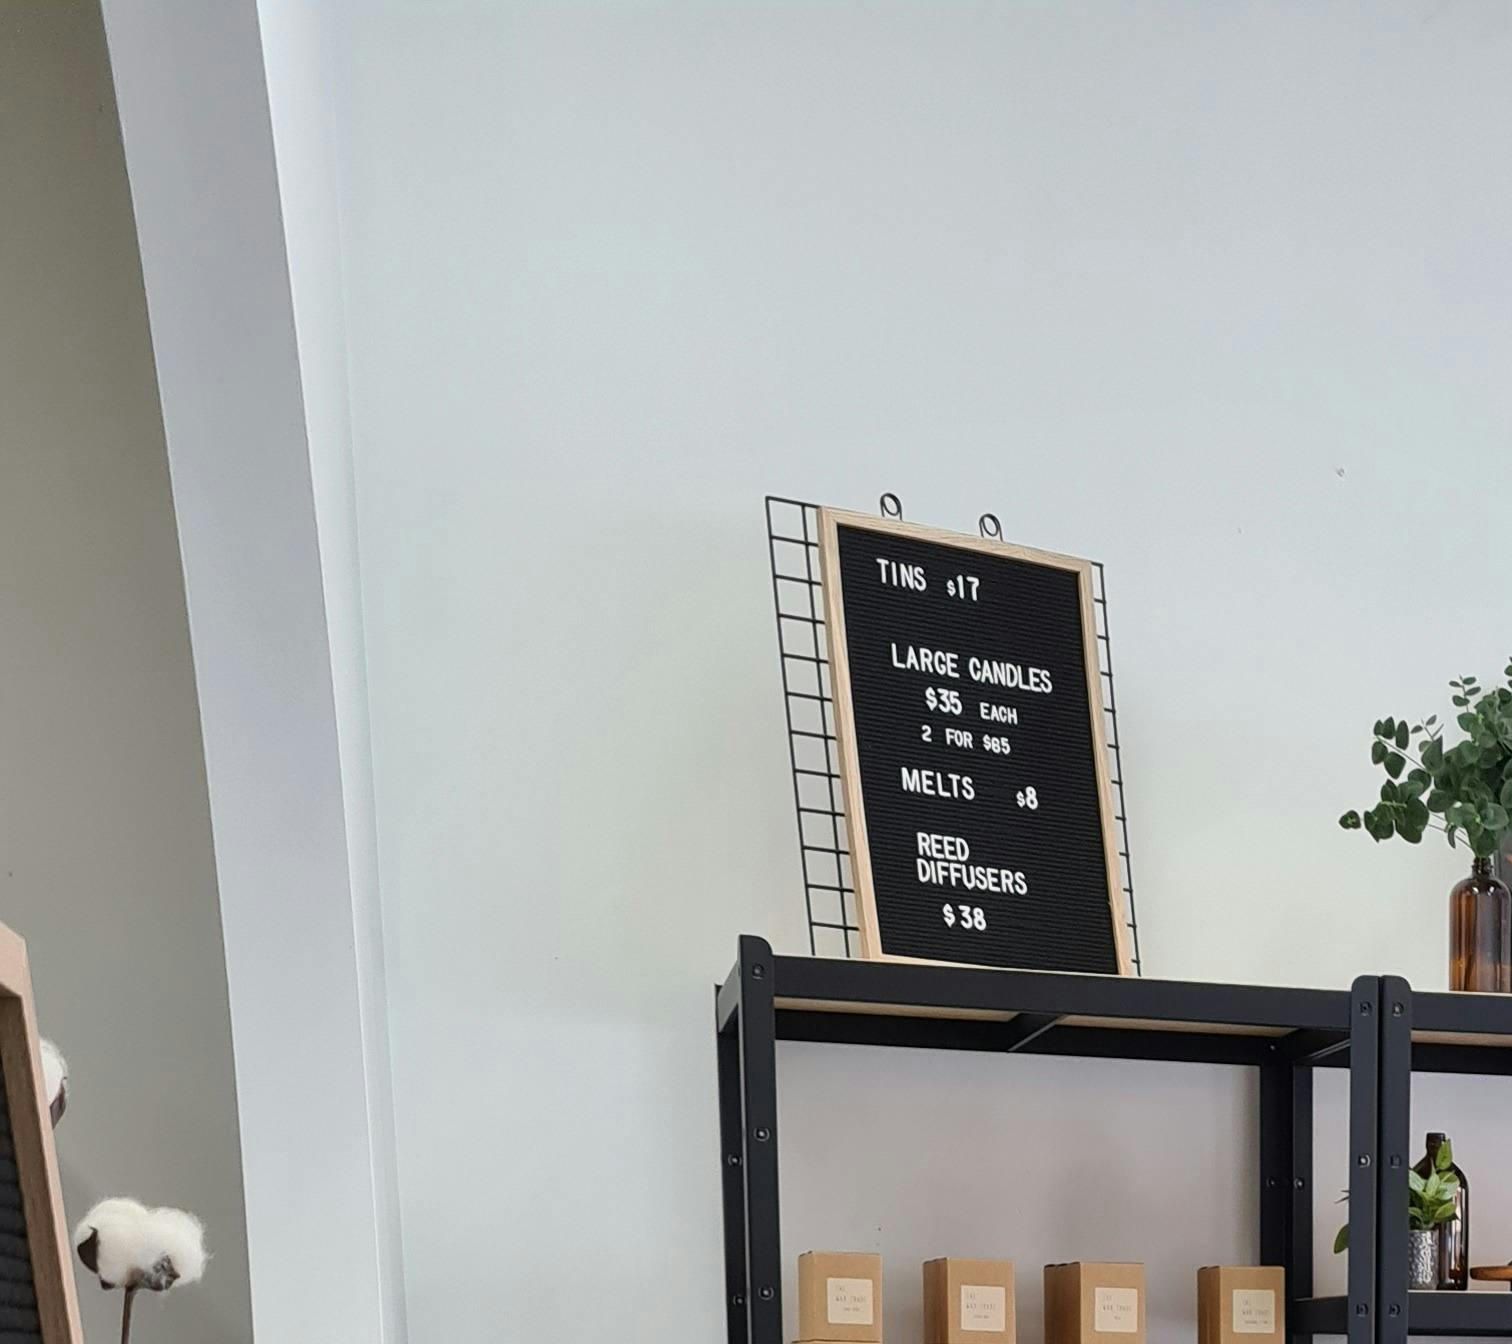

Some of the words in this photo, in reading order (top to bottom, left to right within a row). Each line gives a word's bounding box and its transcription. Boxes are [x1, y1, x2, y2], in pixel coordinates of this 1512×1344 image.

[876, 558, 927, 591] TINS
[947, 575, 979, 600] $17
[891, 643, 960, 678] LARGE
[969, 657, 1052, 693] CANDLES
[925, 687, 962, 715] $35
[980, 702, 1018, 725] EACH
[921, 725, 932, 742] 2
[945, 728, 973, 749] FOR
[901, 767, 975, 800] MELTS
[1015, 786, 1038, 810] $8
[916, 832, 970, 861] REED
[916, 858, 1028, 895] DIFFUSERS
